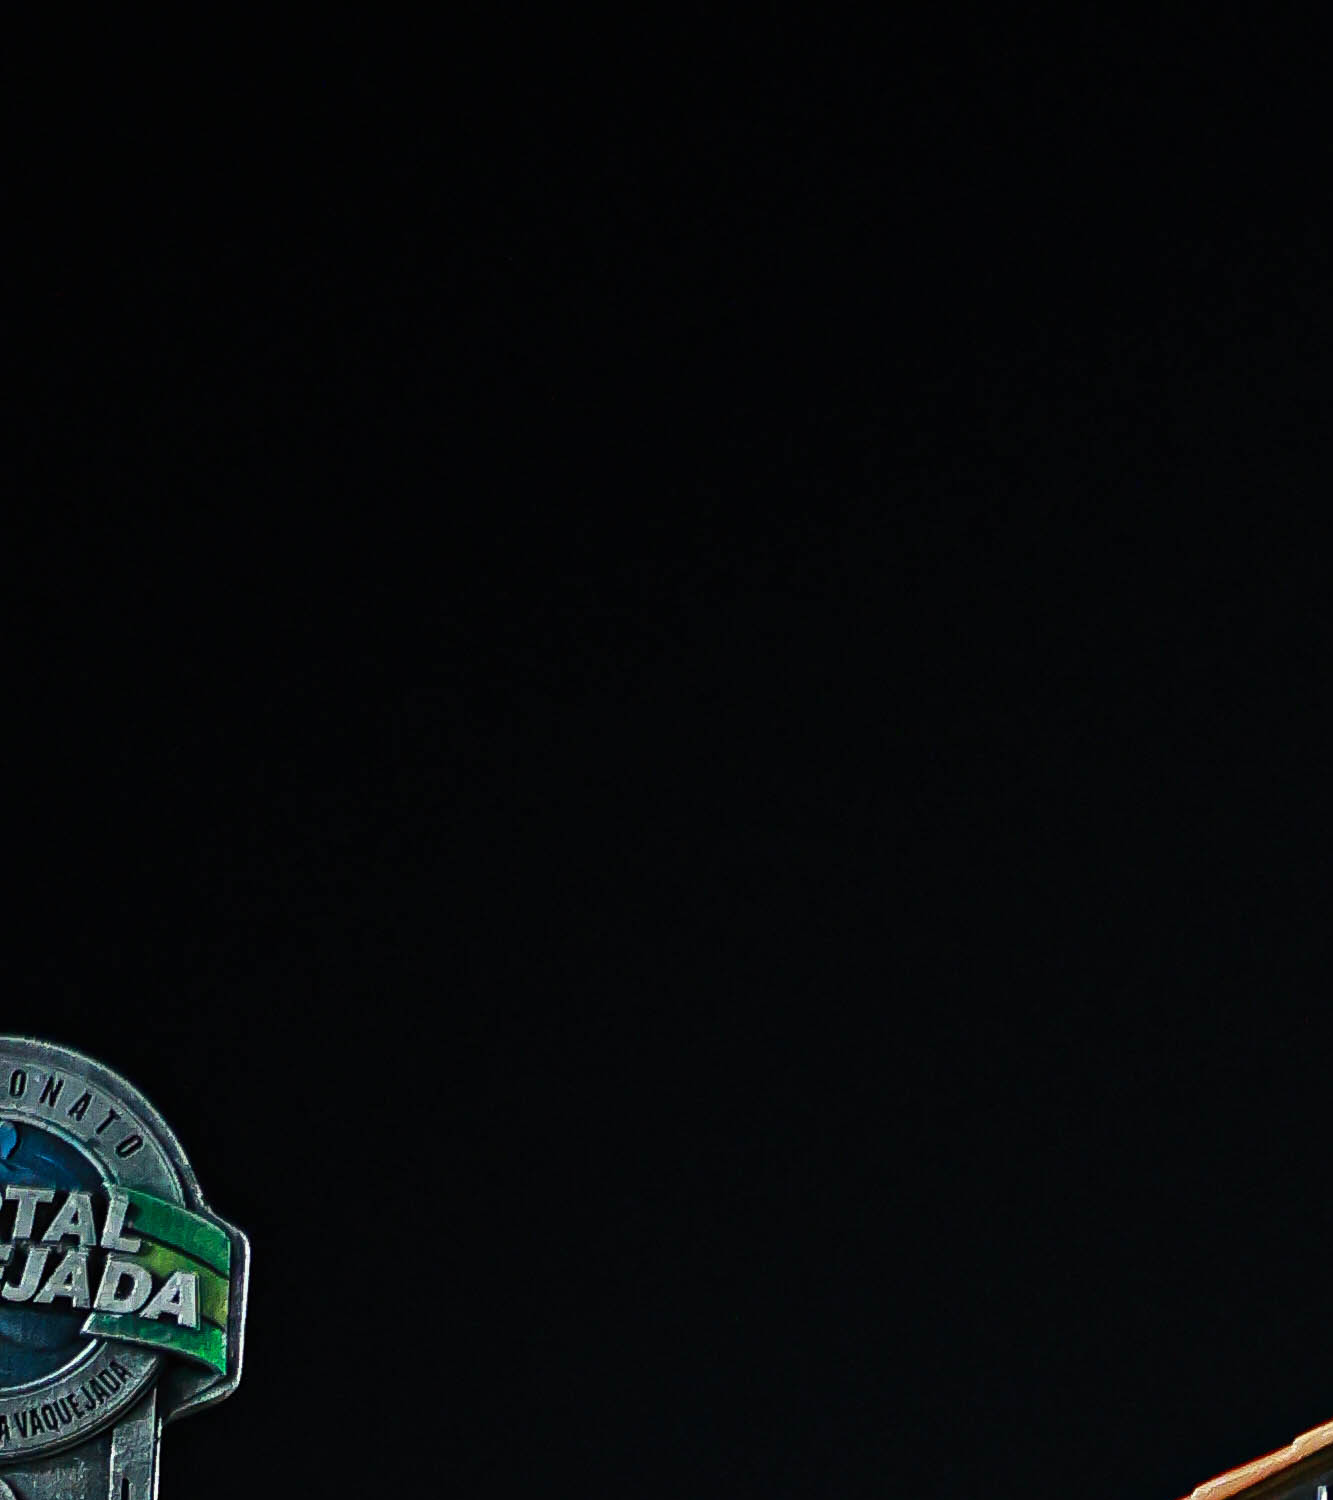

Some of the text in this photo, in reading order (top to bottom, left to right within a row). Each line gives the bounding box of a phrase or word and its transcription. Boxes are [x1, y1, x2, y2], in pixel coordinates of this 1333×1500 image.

[9, 1069, 143, 1158] ONATO
[0, 1184, 141, 1253] TAL
[13, 1360, 134, 1439] VAQUEJADA
